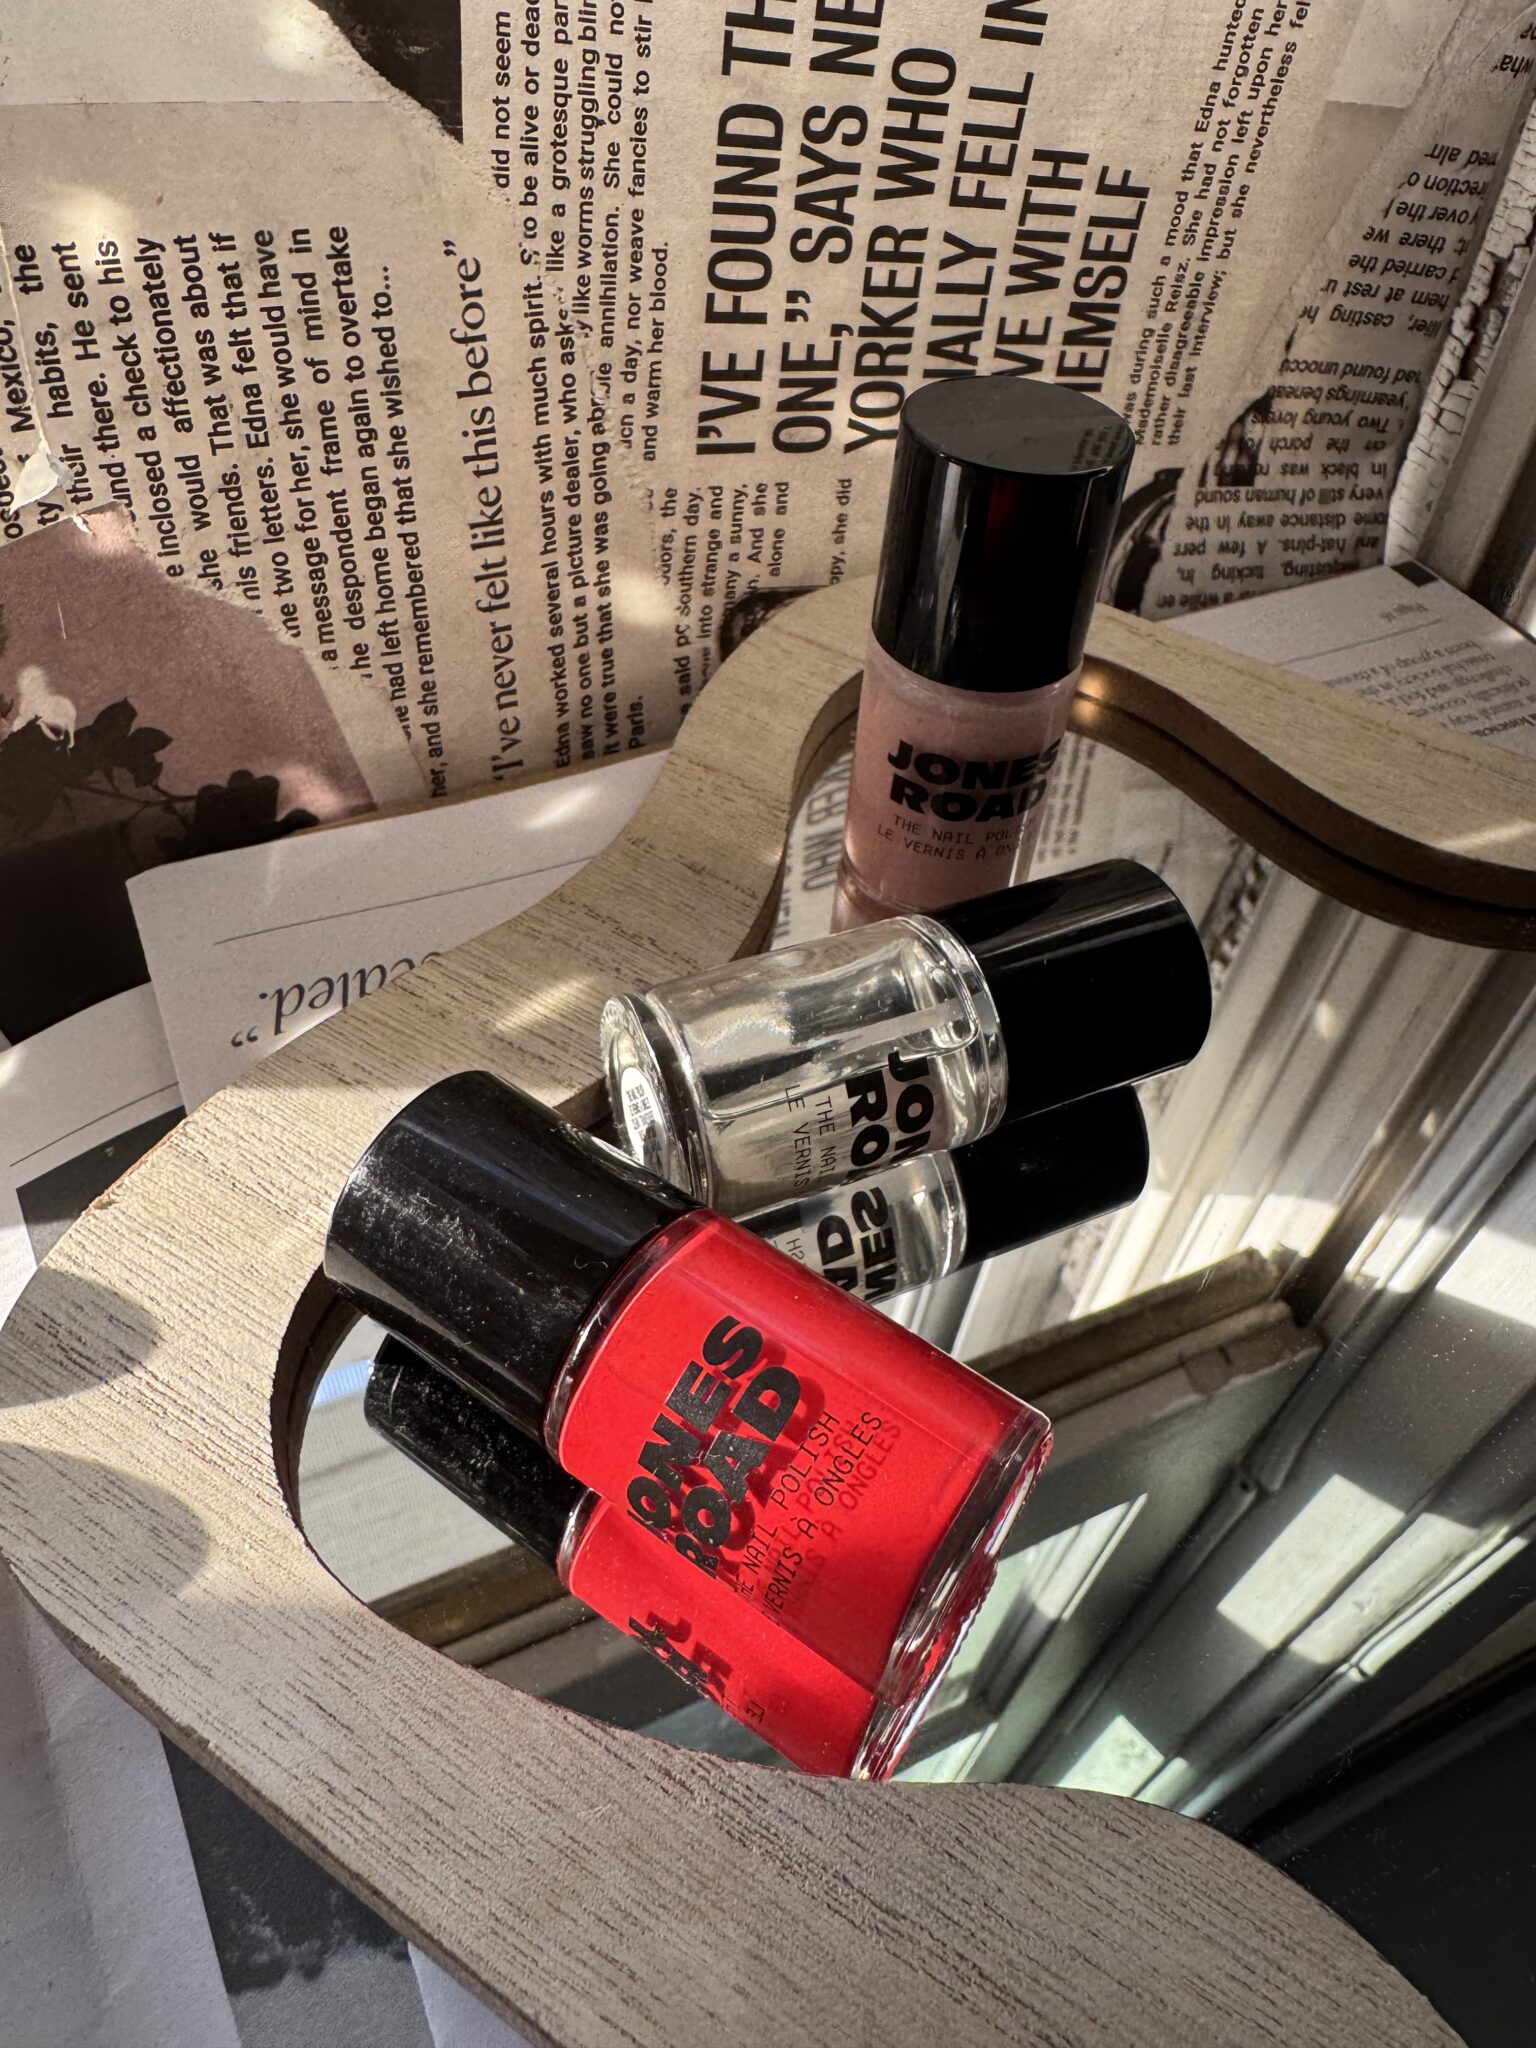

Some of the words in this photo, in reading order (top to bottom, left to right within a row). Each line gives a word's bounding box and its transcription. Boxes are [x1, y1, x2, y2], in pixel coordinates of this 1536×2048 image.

[495, 11, 512, 88] seem
[633, 14, 653, 59] stir
[1221, 7, 1265, 109] forgotten
[494, 95, 511, 140] not
[604, 52, 623, 126] could
[1193, 80, 1222, 133] Edna
[518, 104, 540, 167] alive
[549, 57, 573, 191] grotesque
[627, 106, 649, 198] fancies
[873, 47, 957, 202] WHO
[948, 71, 1035, 211] FELL
[1195, 153, 1240, 262] impression
[1230, 109, 1254, 144] left
[1246, 46, 1274, 101] upon
[1211, 118, 1232, 153] not
[1215, 228, 1238, 260] but
[1229, 183, 1251, 219] she
[1244, 41, 1298, 174] nevertheless
[489, 148, 513, 189] did
[602, 141, 621, 190] She
[789, 104, 869, 265] SAYS
[1180, 141, 1205, 183] that
[1193, 162, 1218, 200] had
[576, 186, 595, 270] worms
[703, 103, 784, 325] FOUND
[1004, 148, 1090, 297] WITH
[1163, 190, 1190, 247] mood
[1181, 209, 1204, 247] She
[1394, 199, 1428, 225] the
[1397, 231, 1447, 256] there
[1427, 203, 1471, 226] over
[12, 244, 45, 296] the
[50, 241, 89, 309] sent
[172, 233, 210, 319] about
[254, 229, 283, 299] have
[545, 229, 566, 272] like
[598, 206, 620, 349] annihilation.
[629, 208, 645, 284] weave
[647, 241, 669, 312] blood.
[1159, 255, 1172, 267] a
[1347, 253, 1379, 274] the
[1379, 257, 1448, 281] carried
[216, 260, 248, 321] that
[290, 271, 325, 342] mind
[324, 226, 362, 348] overtake
[570, 273, 591, 315] like
[626, 291, 642, 330] nor
[1145, 275, 1167, 320] such
[1327, 303, 1395, 328] casting
[1342, 280, 1382, 299] rest
[1383, 286, 1406, 304] at
[133, 237, 194, 434] affectionately
[227, 326, 258, 376] felt
[258, 305, 297, 389] would
[619, 339, 643, 384] day,
[843, 220, 930, 460] YORKER
[1128, 327, 1156, 385] during
[34, 322, 74, 419] habits,
[111, 332, 152, 418] check
[370, 326, 398, 419] wished
[531, 356, 550, 426] much
[557, 372, 578, 425] who
[645, 360, 663, 419] warm
[1339, 359, 1392, 388] found
[87, 372, 121, 454] there.
[203, 393, 235, 457] That
[241, 382, 271, 449] Edna
[316, 399, 344, 477] frame
[347, 388, 379, 459] again
[461, 405, 500, 479] this
[288, 445, 313, 494] her,
[533, 433, 554, 485] with
[560, 429, 582, 508] dealer,
[588, 441, 613, 505] going
[134, 450, 181, 558] inclosed
[173, 454, 212, 532] would
[216, 463, 253, 559] friends.
[256, 456, 286, 546] letters.
[360, 465, 388, 542] began
[466, 485, 506, 552] like
[538, 489, 558, 556] hours
[706, 485, 724, 521] and
[773, 481, 790, 516] and
[835, 477, 853, 507] did
[325, 487, 366, 631] despondent
[566, 513, 590, 589] picture
[746, 527, 765, 564] And
[831, 512, 849, 545] she
[302, 537, 336, 645] message
[371, 547, 397, 617] home
[396, 532, 433, 676] remembered
[472, 555, 511, 614] felt
[539, 560, 565, 638] several
[592, 559, 612, 598] she
[376, 617, 402, 657] left
[571, 612, 589, 649] but
[595, 601, 614, 645] that
[489, 620, 519, 712] never
[546, 643, 570, 718] worked
[577, 651, 593, 690] one
[600, 647, 616, 689] true
[603, 691, 619, 738] were
[890, 773, 1047, 822] ROAD
[893, 813, 921, 836] THE
[932, 829, 974, 845] NAIL
[878, 824, 894, 842] LE
[904, 837, 965, 861] VERNIS
[785, 1085, 805, 1112] LE
[815, 1095, 835, 1136] THE
[793, 1122, 811, 1188] VERNIS
[741, 1524, 778, 1576] NAIL
[770, 1411, 840, 1511] POLISH
[763, 1546, 802, 1614] VERNIS
[814, 1411, 883, 1507] ONGLES
